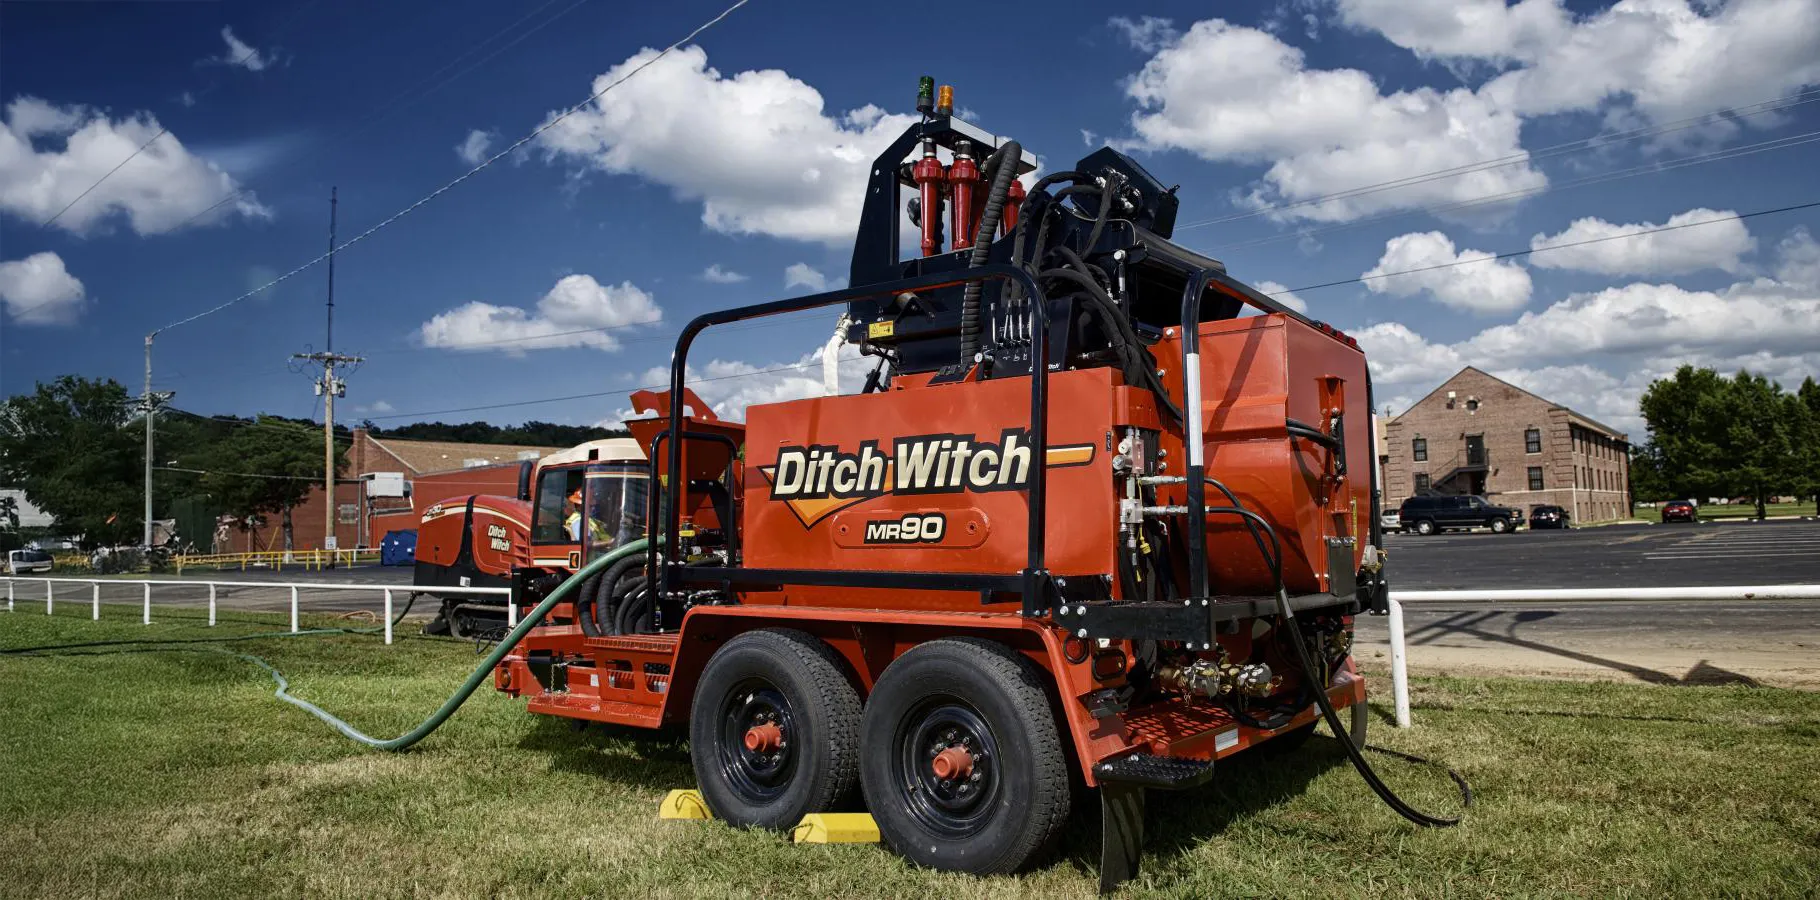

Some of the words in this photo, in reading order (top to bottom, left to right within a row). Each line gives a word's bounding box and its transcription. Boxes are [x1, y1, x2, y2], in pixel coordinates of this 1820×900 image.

[774, 446, 884, 495] Ditch
[897, 435, 1031, 489] Witch
[487, 524, 507, 538] Ditch
[866, 516, 943, 540] MR90
[490, 537, 510, 552] Witch
